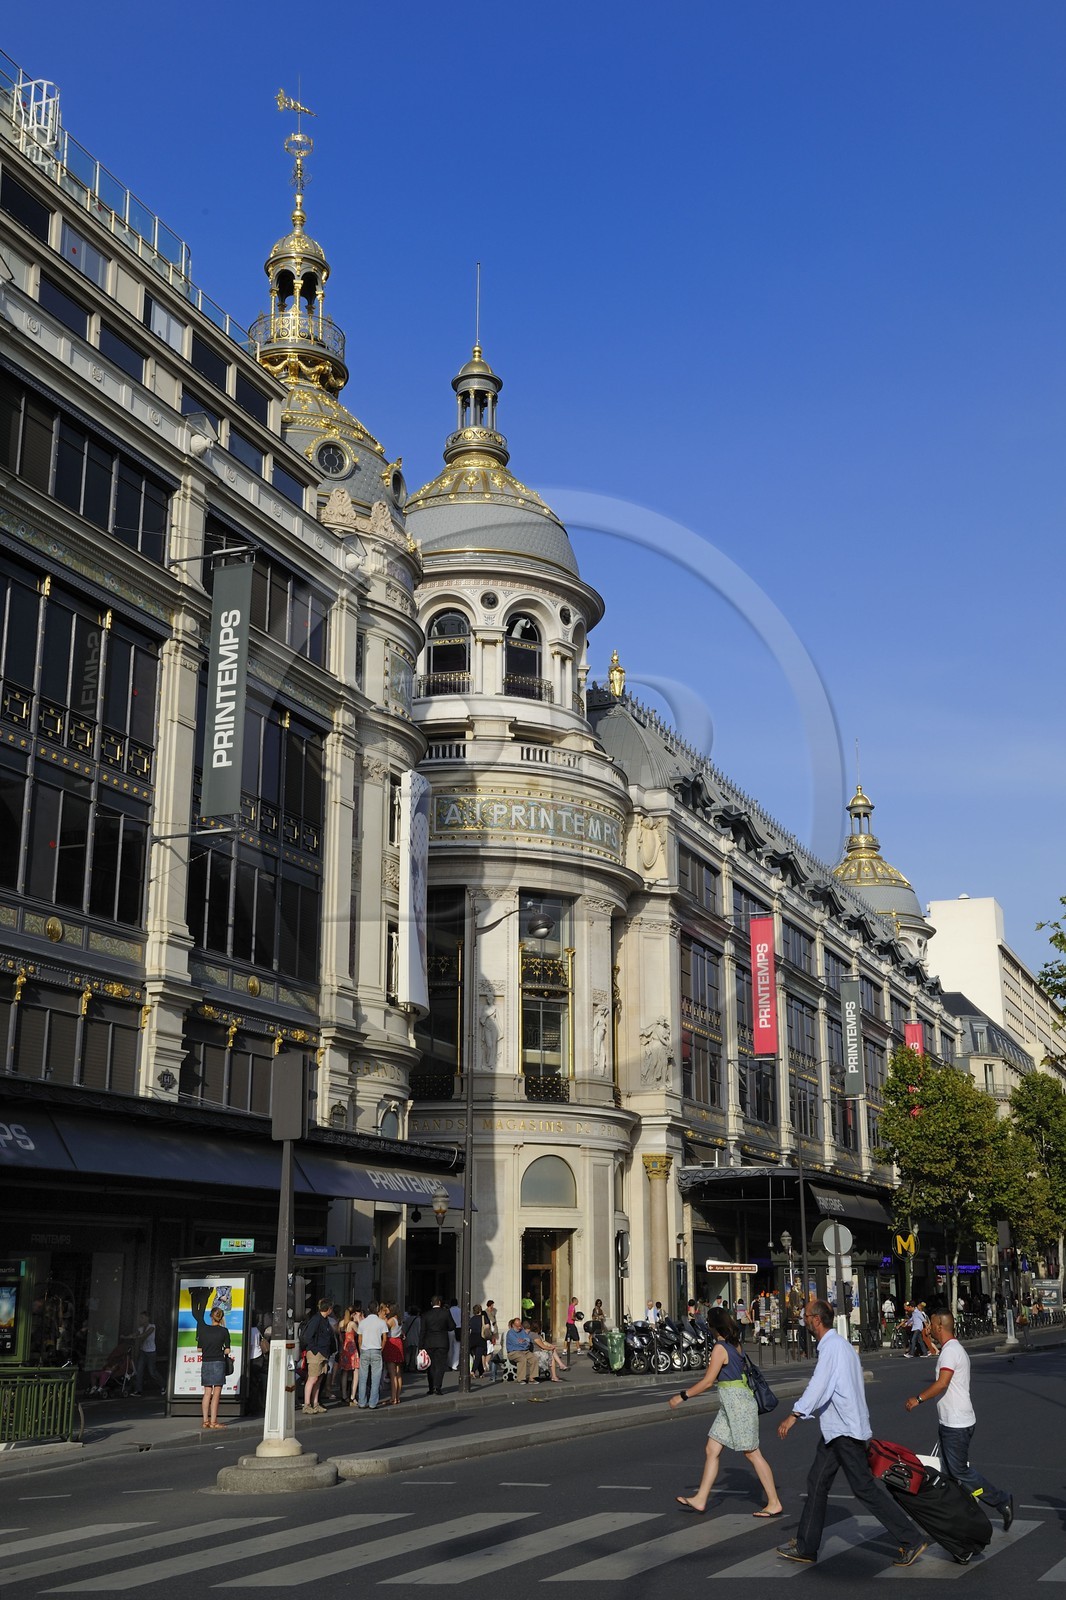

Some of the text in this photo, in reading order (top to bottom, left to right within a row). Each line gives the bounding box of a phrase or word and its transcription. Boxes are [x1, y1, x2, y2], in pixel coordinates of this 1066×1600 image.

[212, 609, 241, 769] PRINTEMPS
[444, 803, 618, 848] AU PRINTEMPS
[756, 942, 772, 1029] PRINTEMPS
[845, 1001, 859, 1074] PRINTEMPS
[350, 1060, 401, 1081] GRANDS
[411, 1119, 466, 1131] RANDS
[482, 1119, 564, 1132] MAGASINS
[366, 1169, 450, 1196] PRINTEMPS
[31, 1234, 72, 1246] PRINTEMPS
[896, 1233, 916, 1255] M
[183, 1355, 195, 1363] Les
